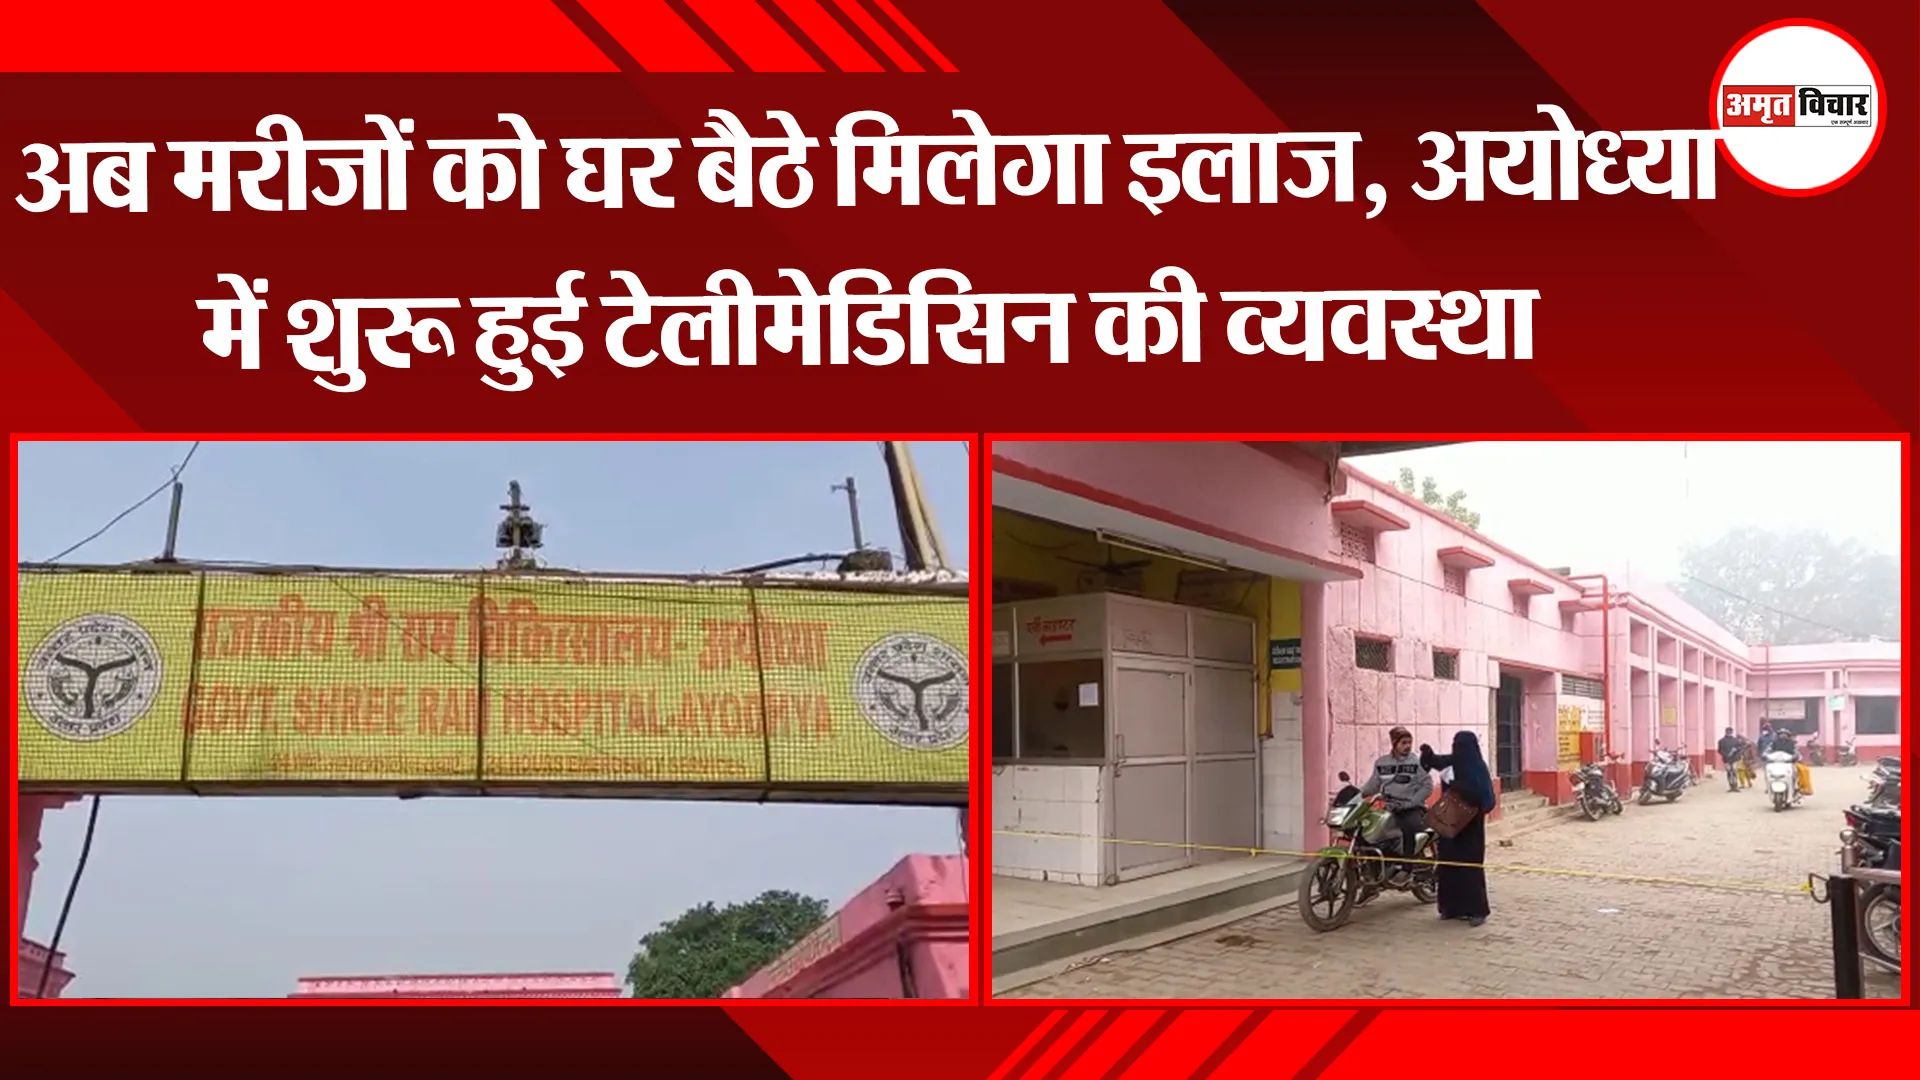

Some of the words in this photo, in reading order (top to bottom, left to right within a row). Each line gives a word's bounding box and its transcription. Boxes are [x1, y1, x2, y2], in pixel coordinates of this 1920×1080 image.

[194, 594, 337, 662] ाजकीय
[348, 595, 388, 663] श्री
[402, 609, 459, 665] राम
[293, 682, 405, 738] SHREE
